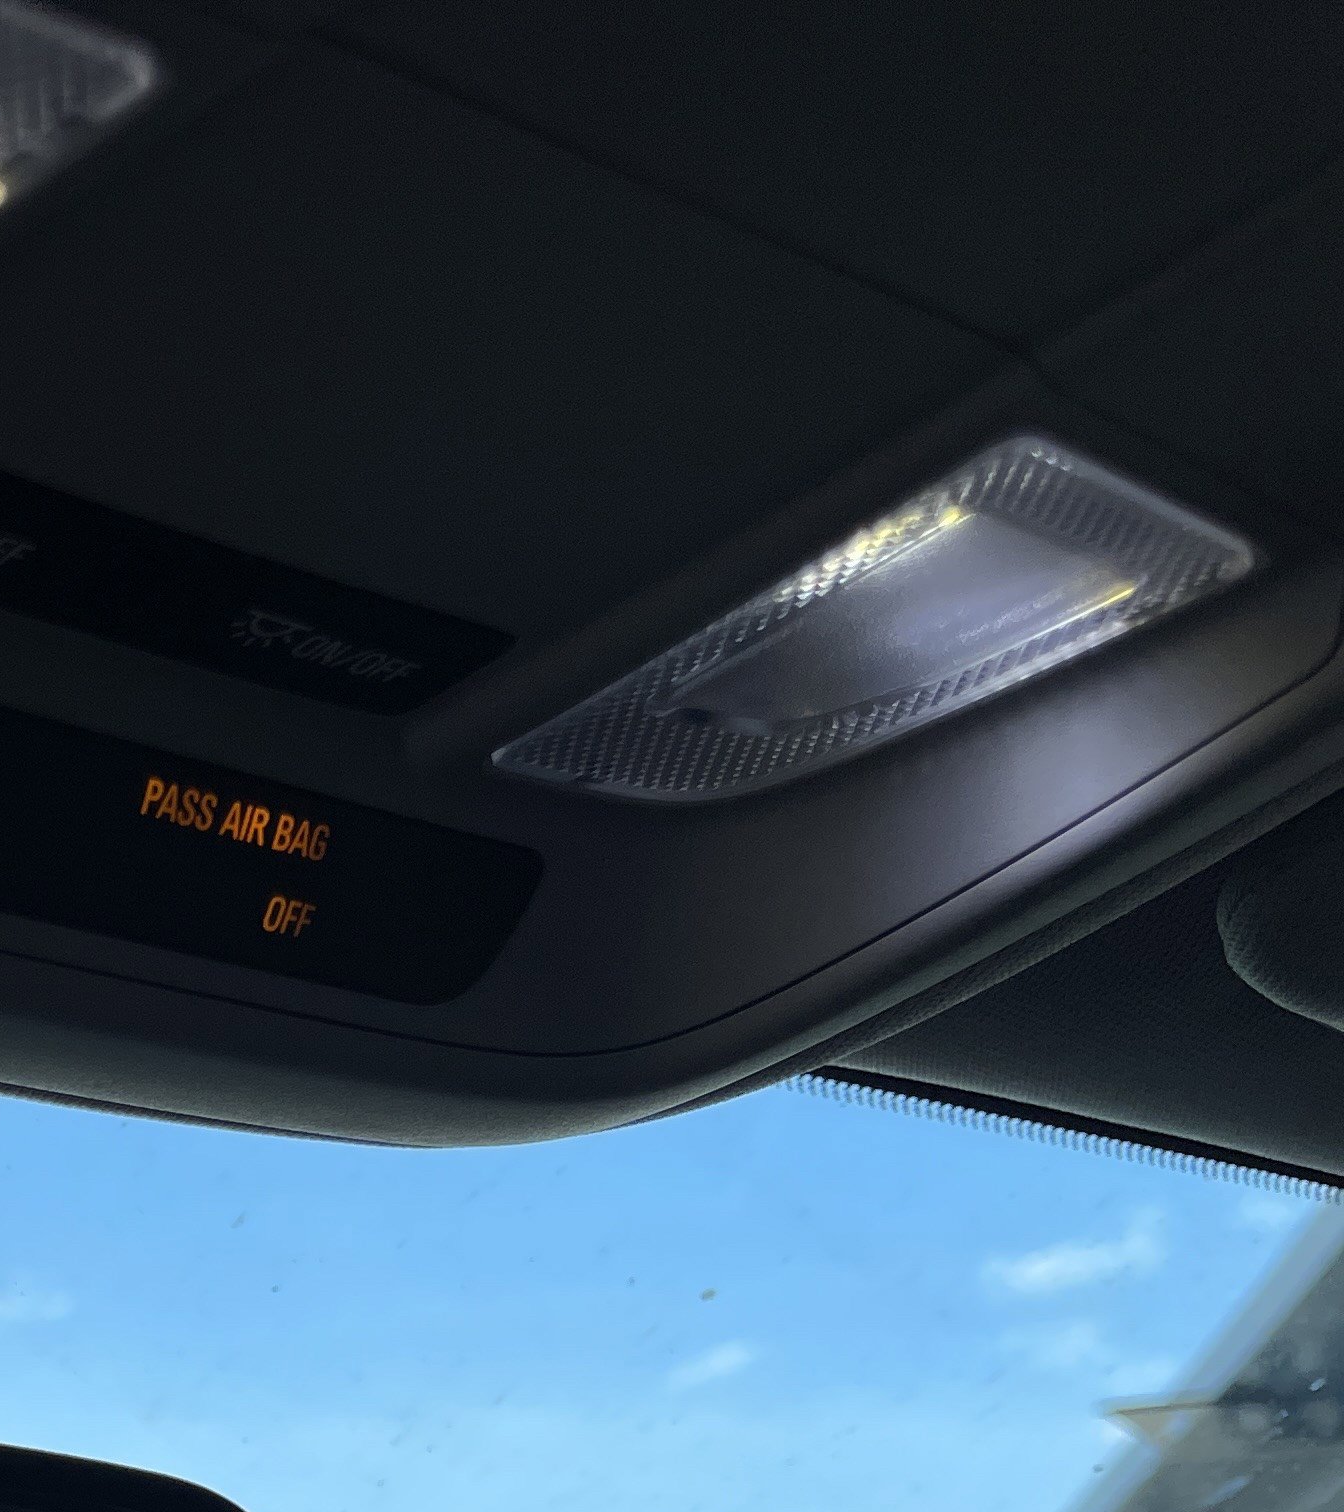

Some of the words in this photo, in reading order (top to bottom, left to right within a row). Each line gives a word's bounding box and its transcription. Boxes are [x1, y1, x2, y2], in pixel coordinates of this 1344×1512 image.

[294, 636, 420, 682] ON/OFF
[140, 777, 219, 831] PASS
[218, 801, 270, 847] AIR
[271, 813, 331, 861] BAG
[262, 895, 316, 938] OFF
